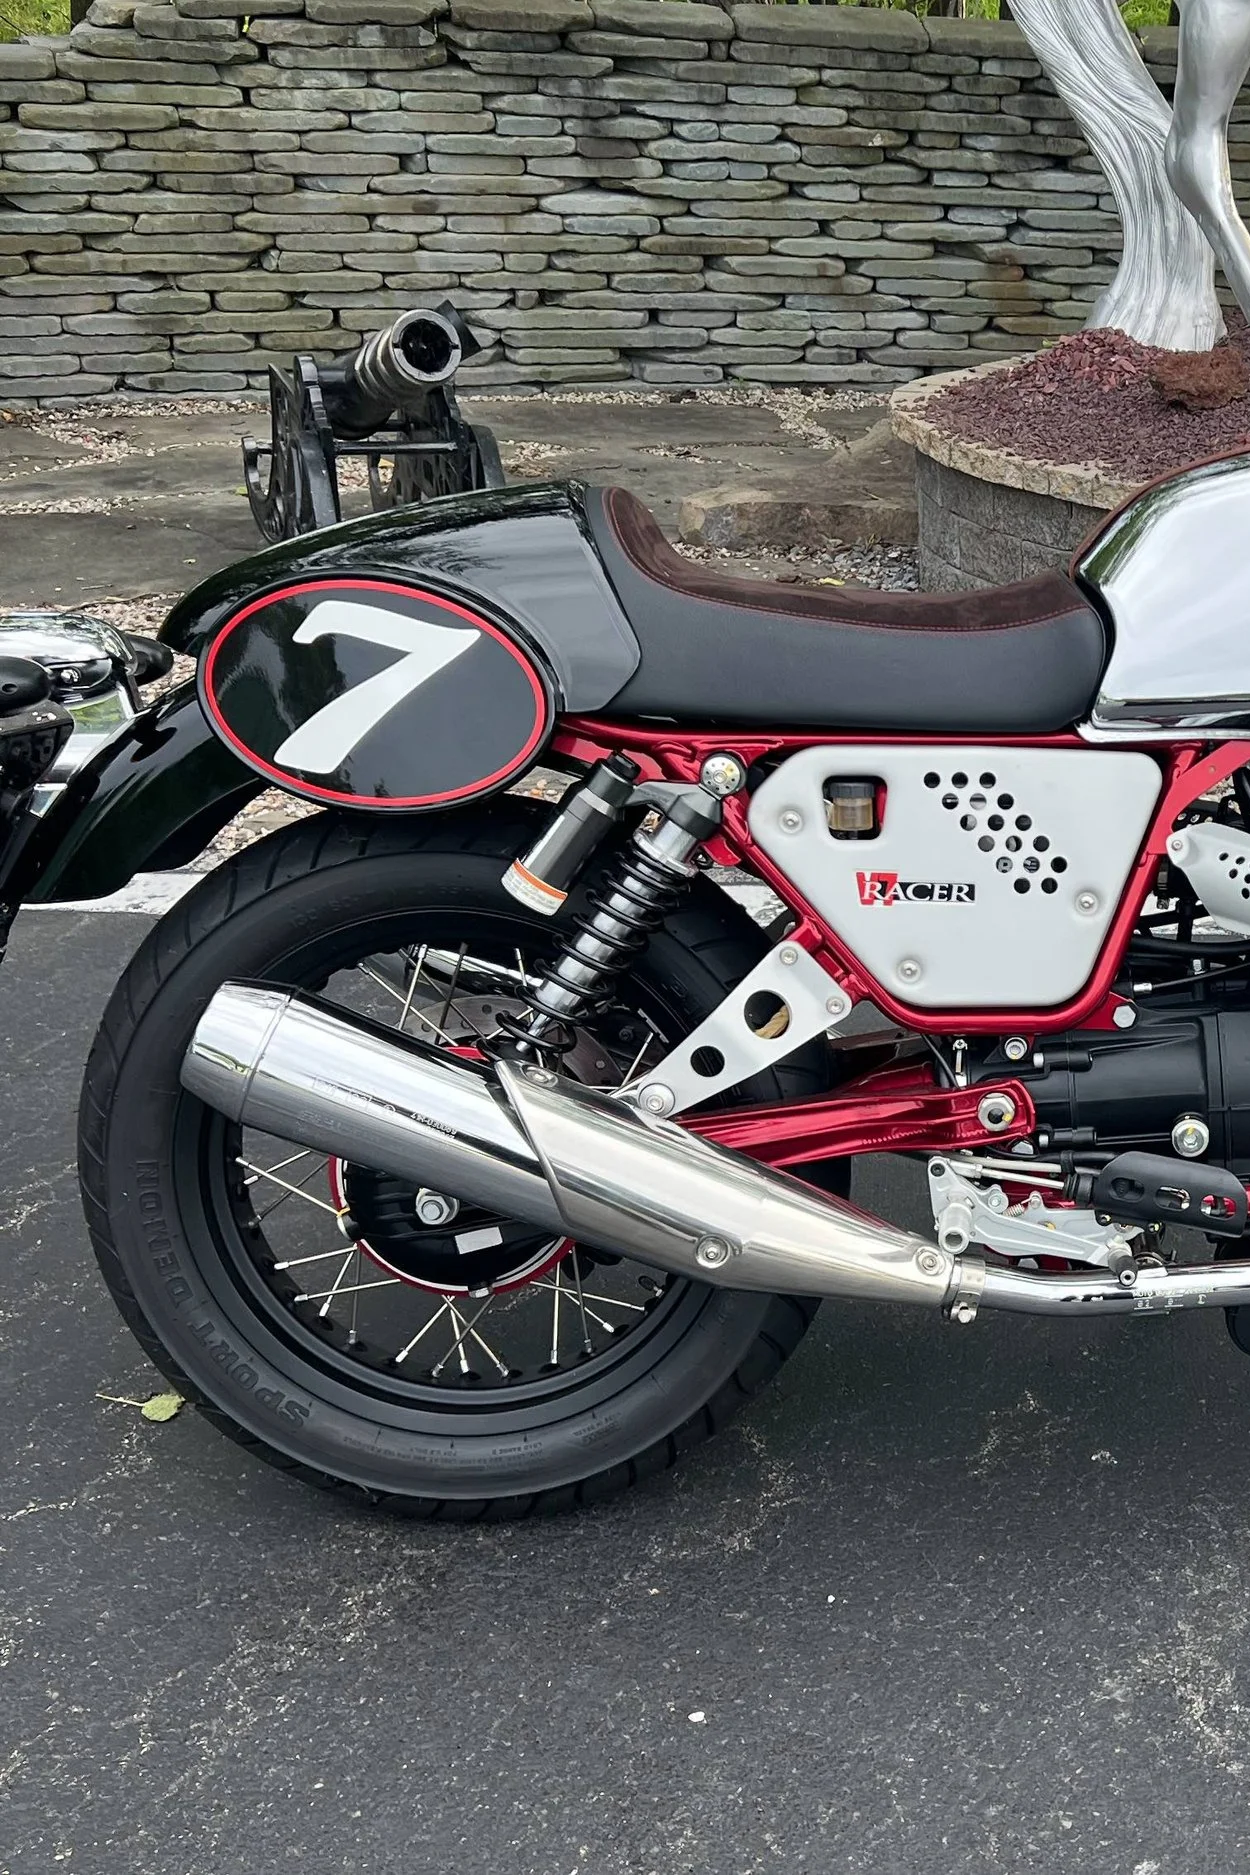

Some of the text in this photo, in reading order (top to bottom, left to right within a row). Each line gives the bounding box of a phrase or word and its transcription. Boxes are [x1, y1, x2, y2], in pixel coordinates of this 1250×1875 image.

[273, 600, 481, 774] 7
[863, 880, 975, 902] RACER
[135, 1159, 312, 1428] SPORT DEMON
